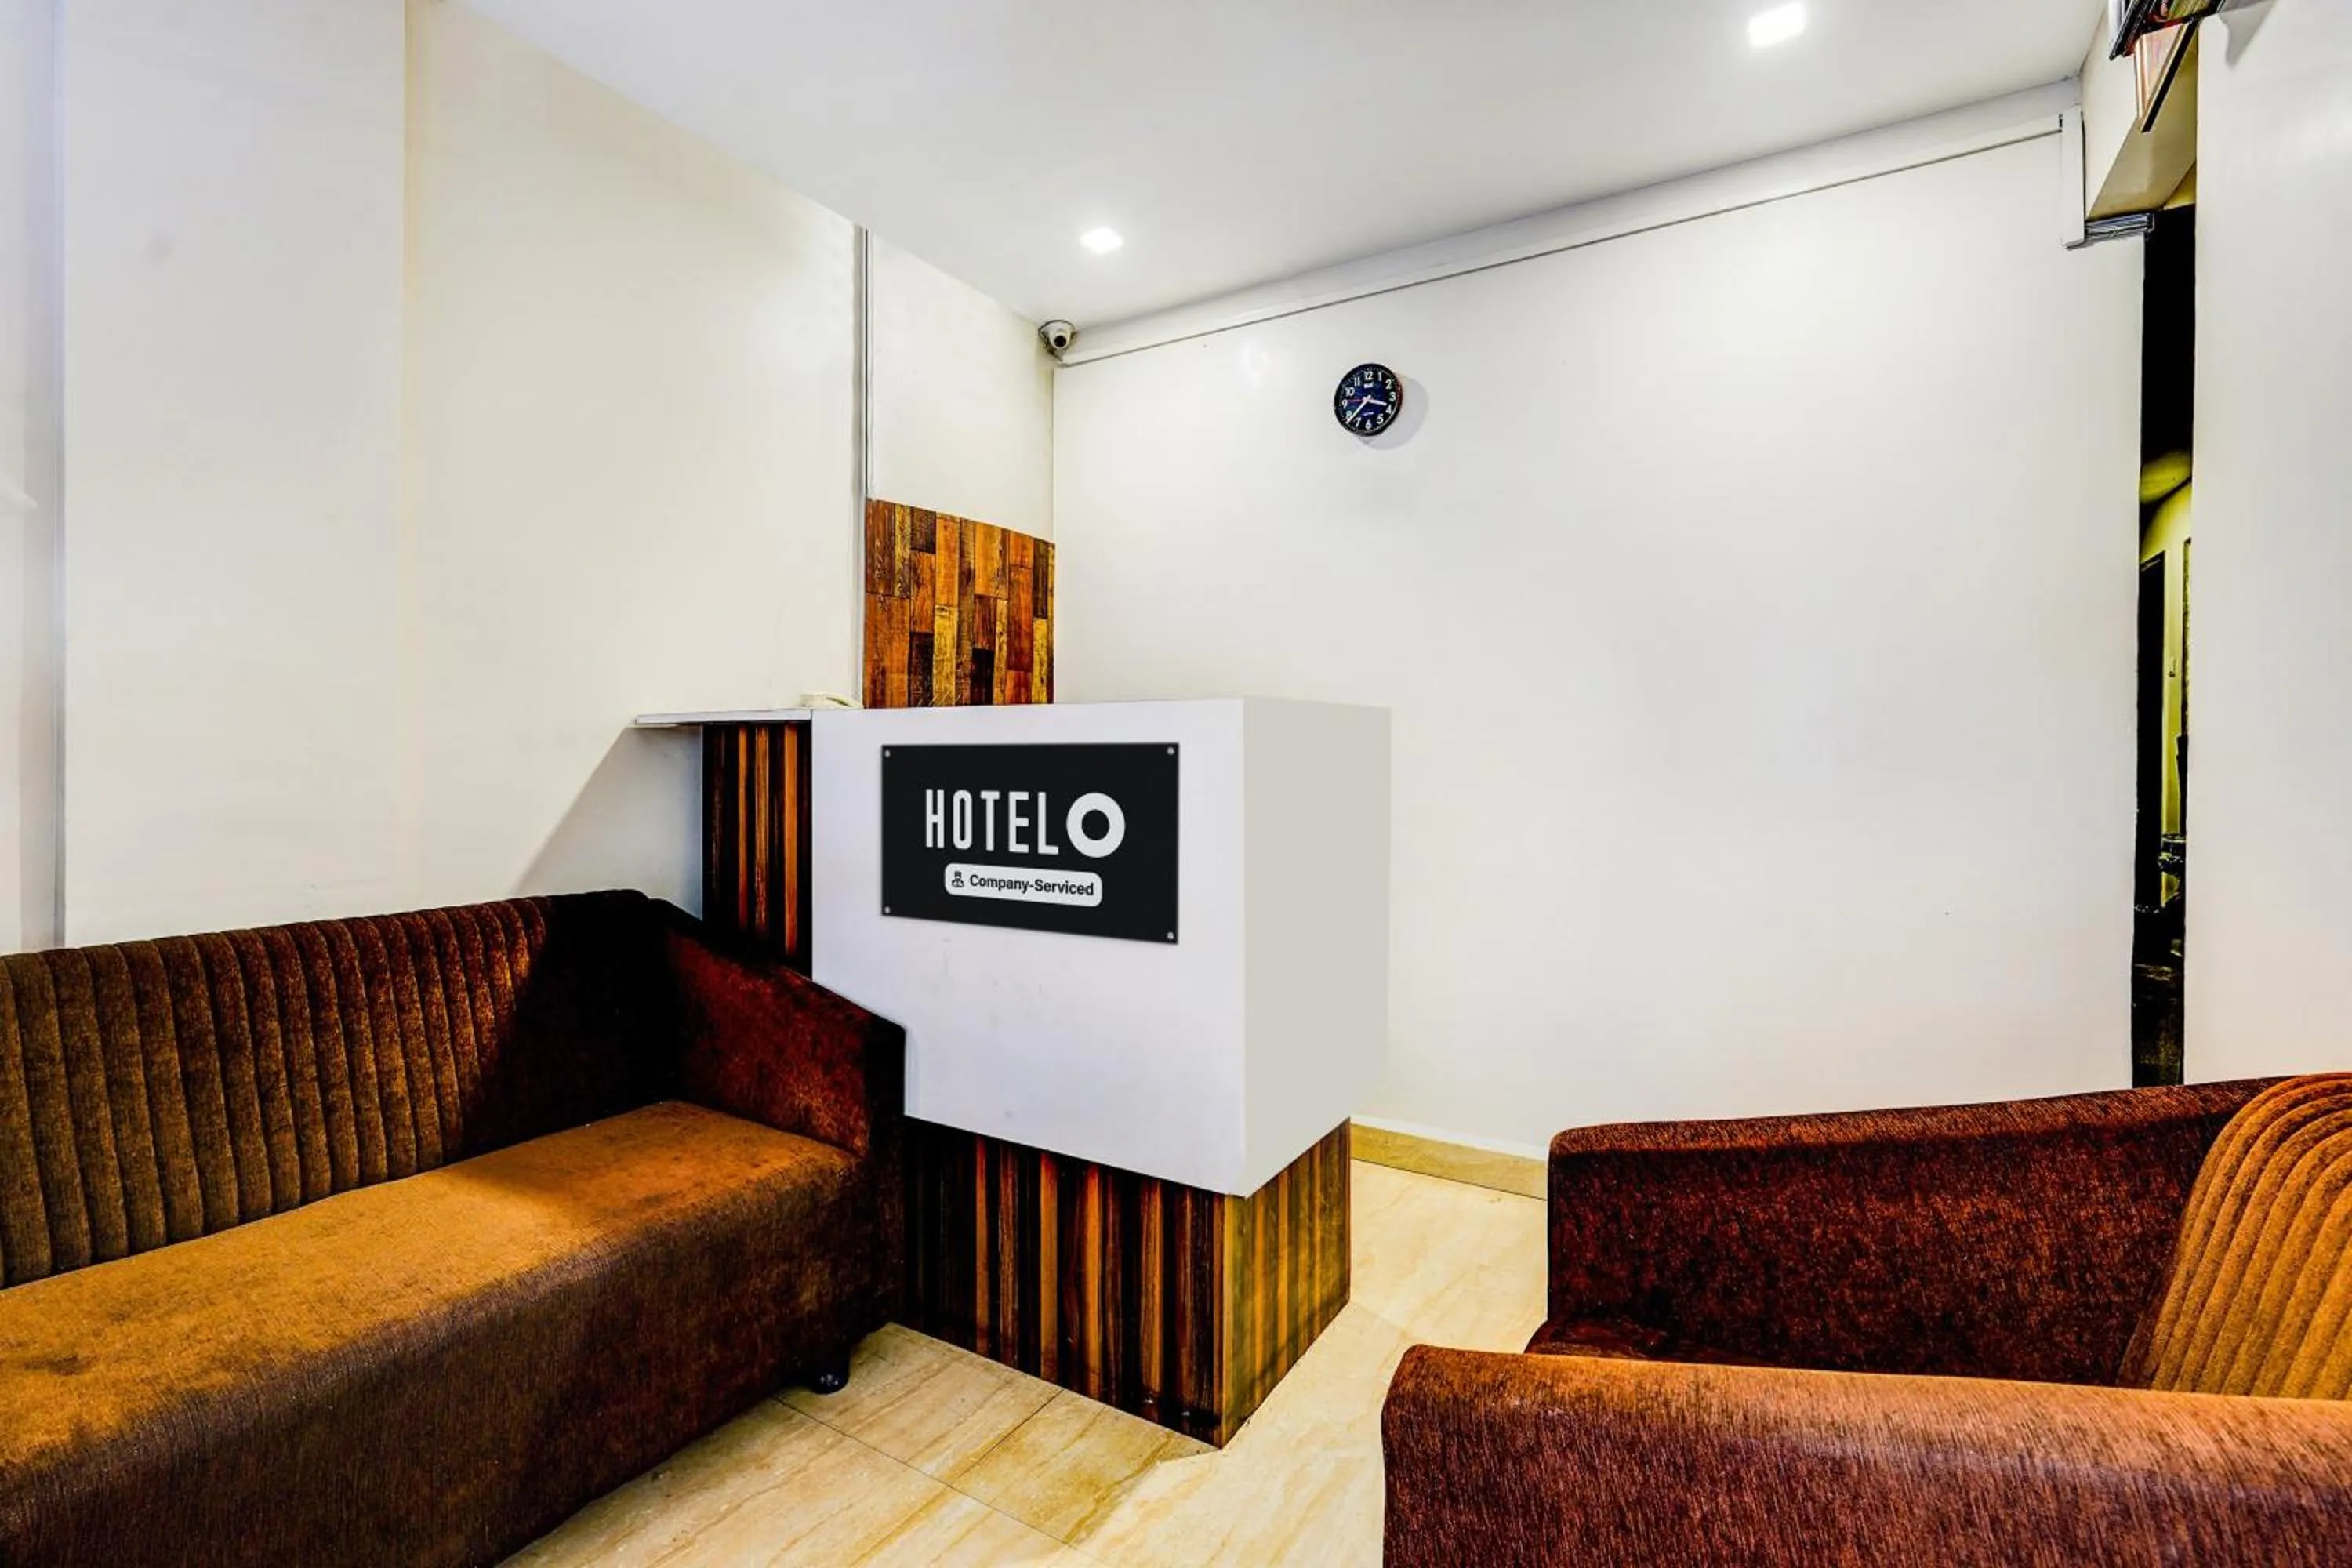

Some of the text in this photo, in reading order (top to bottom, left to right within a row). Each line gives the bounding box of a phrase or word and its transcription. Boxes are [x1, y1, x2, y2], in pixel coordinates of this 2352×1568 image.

[1364, 371, 1374, 380] 12
[1377, 372, 1382, 381] 1
[1354, 376, 1361, 386] 11
[1385, 379, 1392, 389] 2
[1345, 387, 1356, 396] 10
[1389, 391, 1396, 401] 3
[1341, 399, 1348, 408] 9
[1385, 405, 1392, 414] 4
[1354, 417, 1361, 427] 7
[1377, 413, 1384, 423] 5
[1365, 419, 1372, 429] 6
[925, 789, 1059, 855] HOTEL
[969, 873, 1094, 896] Company-Serviced
